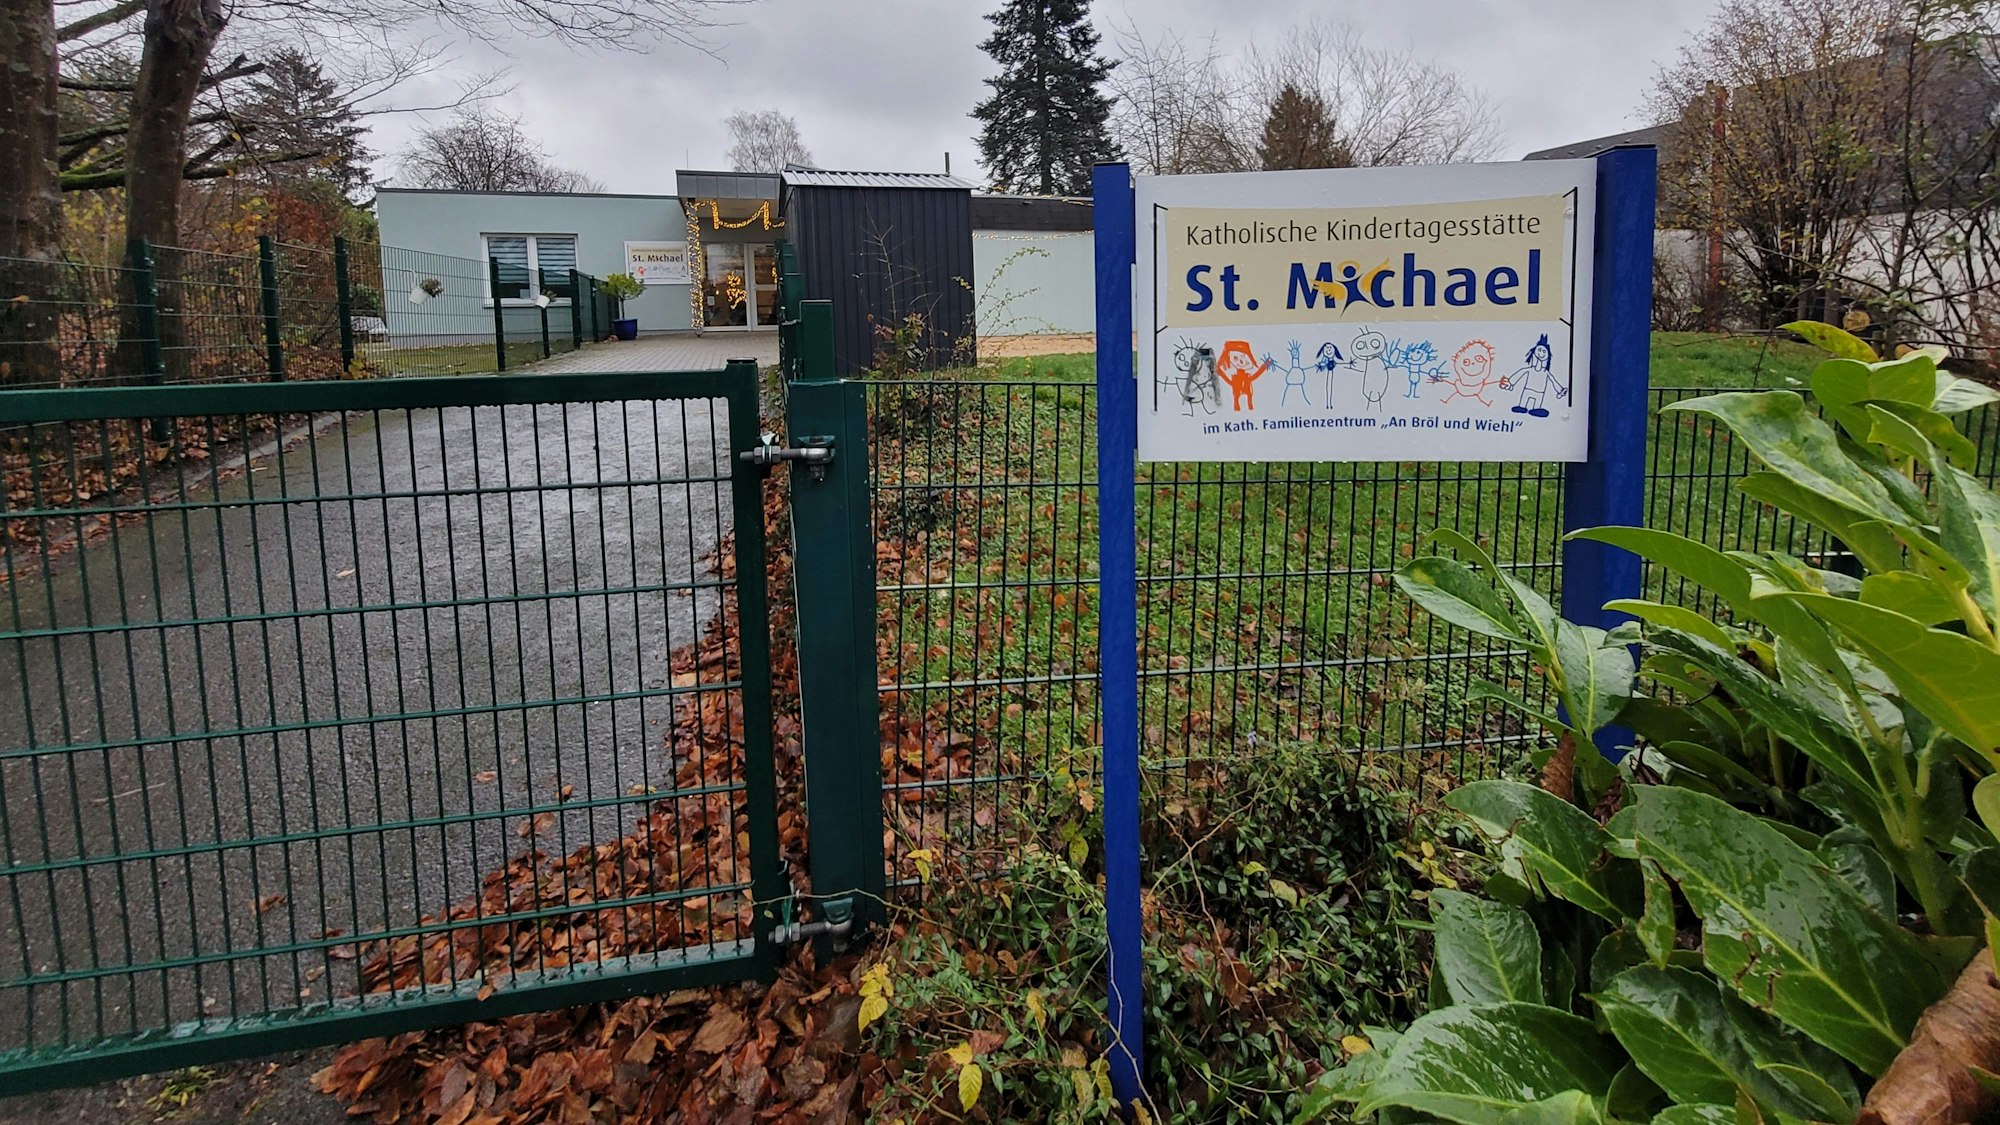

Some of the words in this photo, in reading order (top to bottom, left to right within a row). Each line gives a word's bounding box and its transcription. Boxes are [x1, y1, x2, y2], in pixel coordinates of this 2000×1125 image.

[1187, 221, 1317, 246] Katholische
[1327, 213, 1541, 243] Kindertagesstätte
[648, 254, 683, 262] Michael
[1185, 264, 1259, 311] St.
[1286, 249, 1541, 317] Michael
[1203, 422, 1220, 434] im
[1224, 418, 1258, 432] Kath.
[1262, 415, 1376, 430] Familienzentrum
[1380, 417, 1407, 429] „An
[1411, 415, 1439, 429] Bröl
[1443, 416, 1470, 430] und
